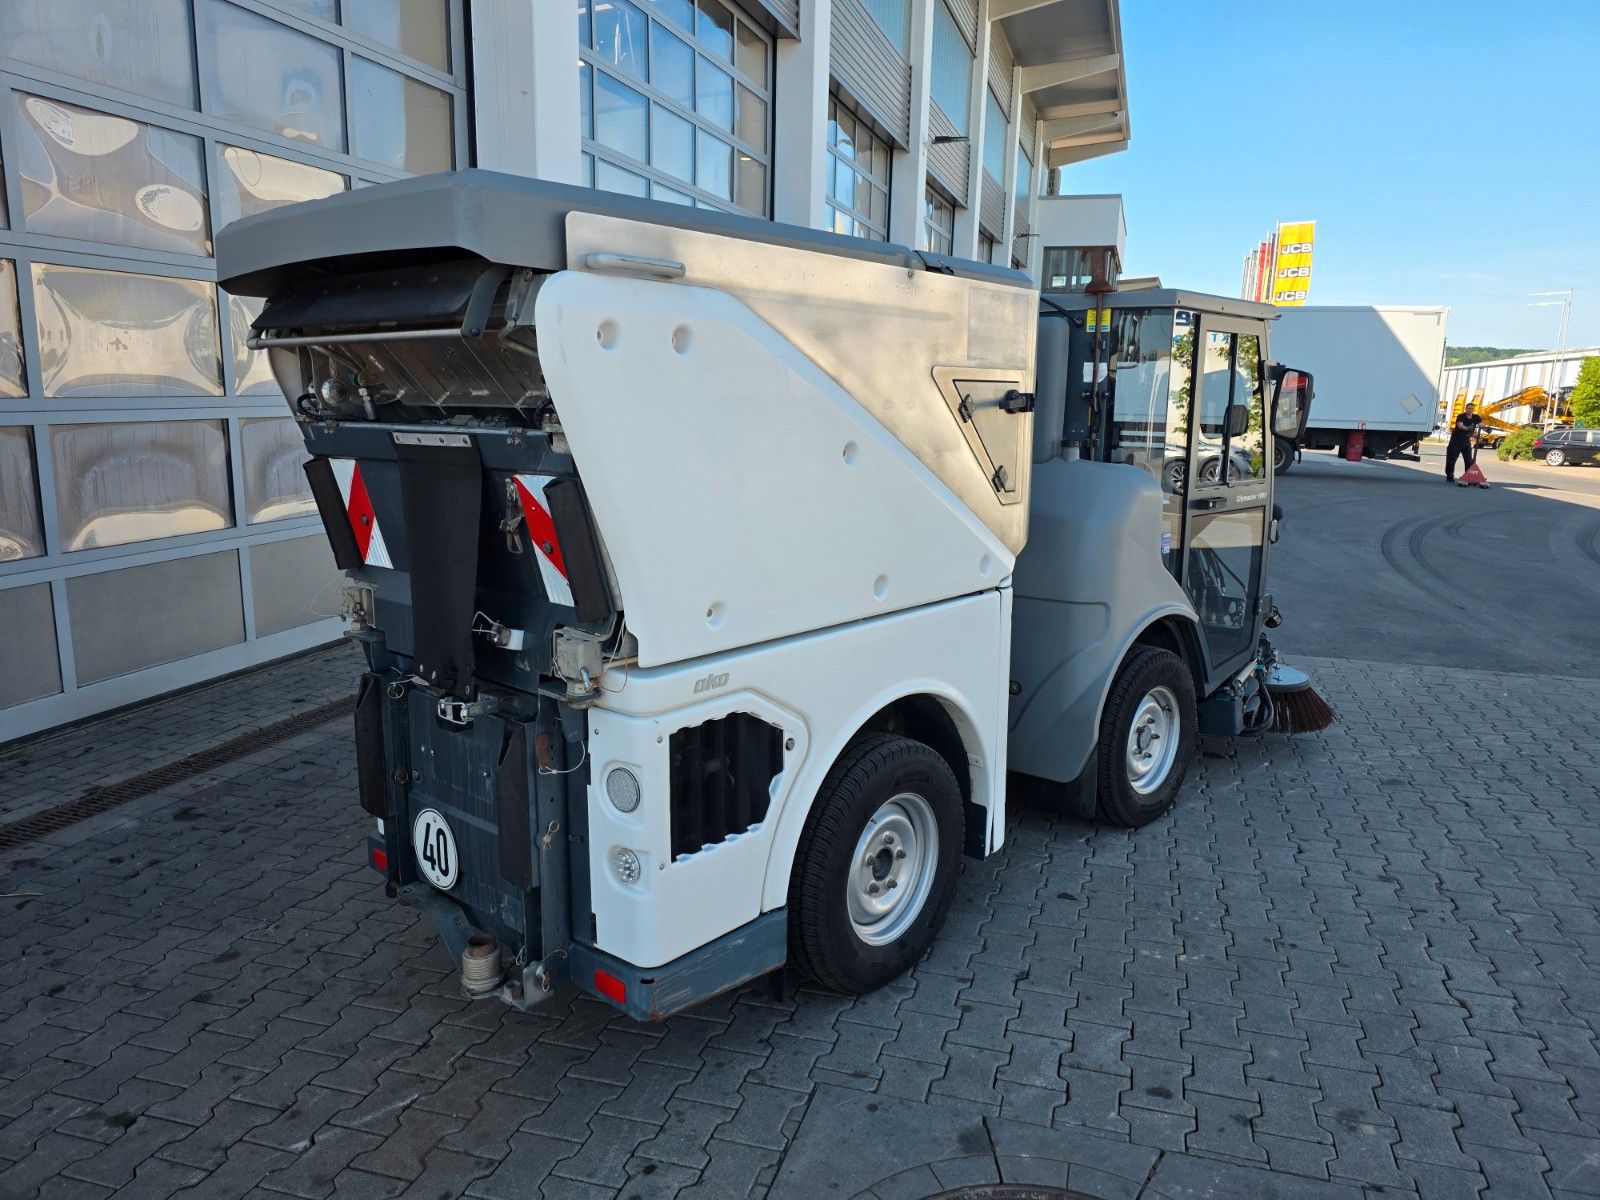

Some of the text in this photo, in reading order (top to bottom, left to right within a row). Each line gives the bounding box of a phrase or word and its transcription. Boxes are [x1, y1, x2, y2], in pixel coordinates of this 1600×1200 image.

[1281, 243, 1312, 255] JCB
[1278, 267, 1310, 278] JCB
[1275, 291, 1307, 301] JCB
[423, 822, 449, 877] 40
